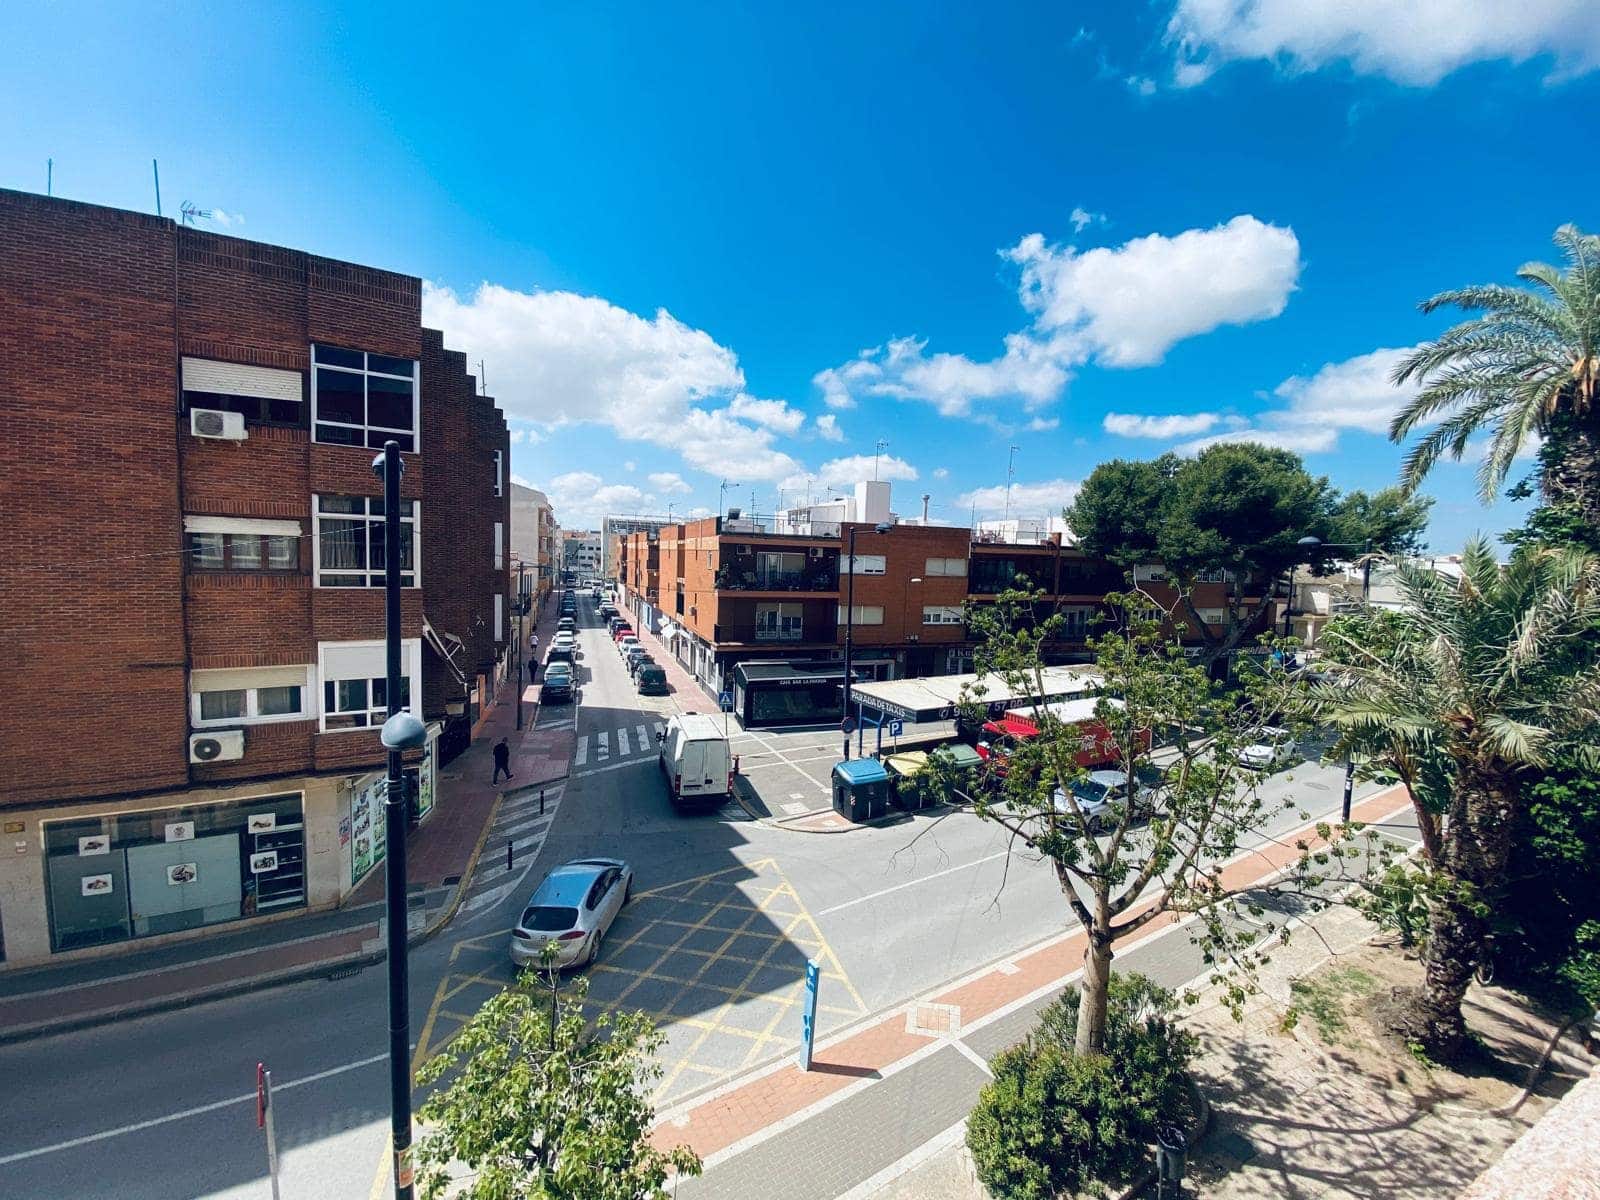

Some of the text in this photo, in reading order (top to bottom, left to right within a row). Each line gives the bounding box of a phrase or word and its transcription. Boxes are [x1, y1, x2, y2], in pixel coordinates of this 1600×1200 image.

[851, 690, 906, 717] PARADA DE TAXIS
[891, 722, 900, 736] P
